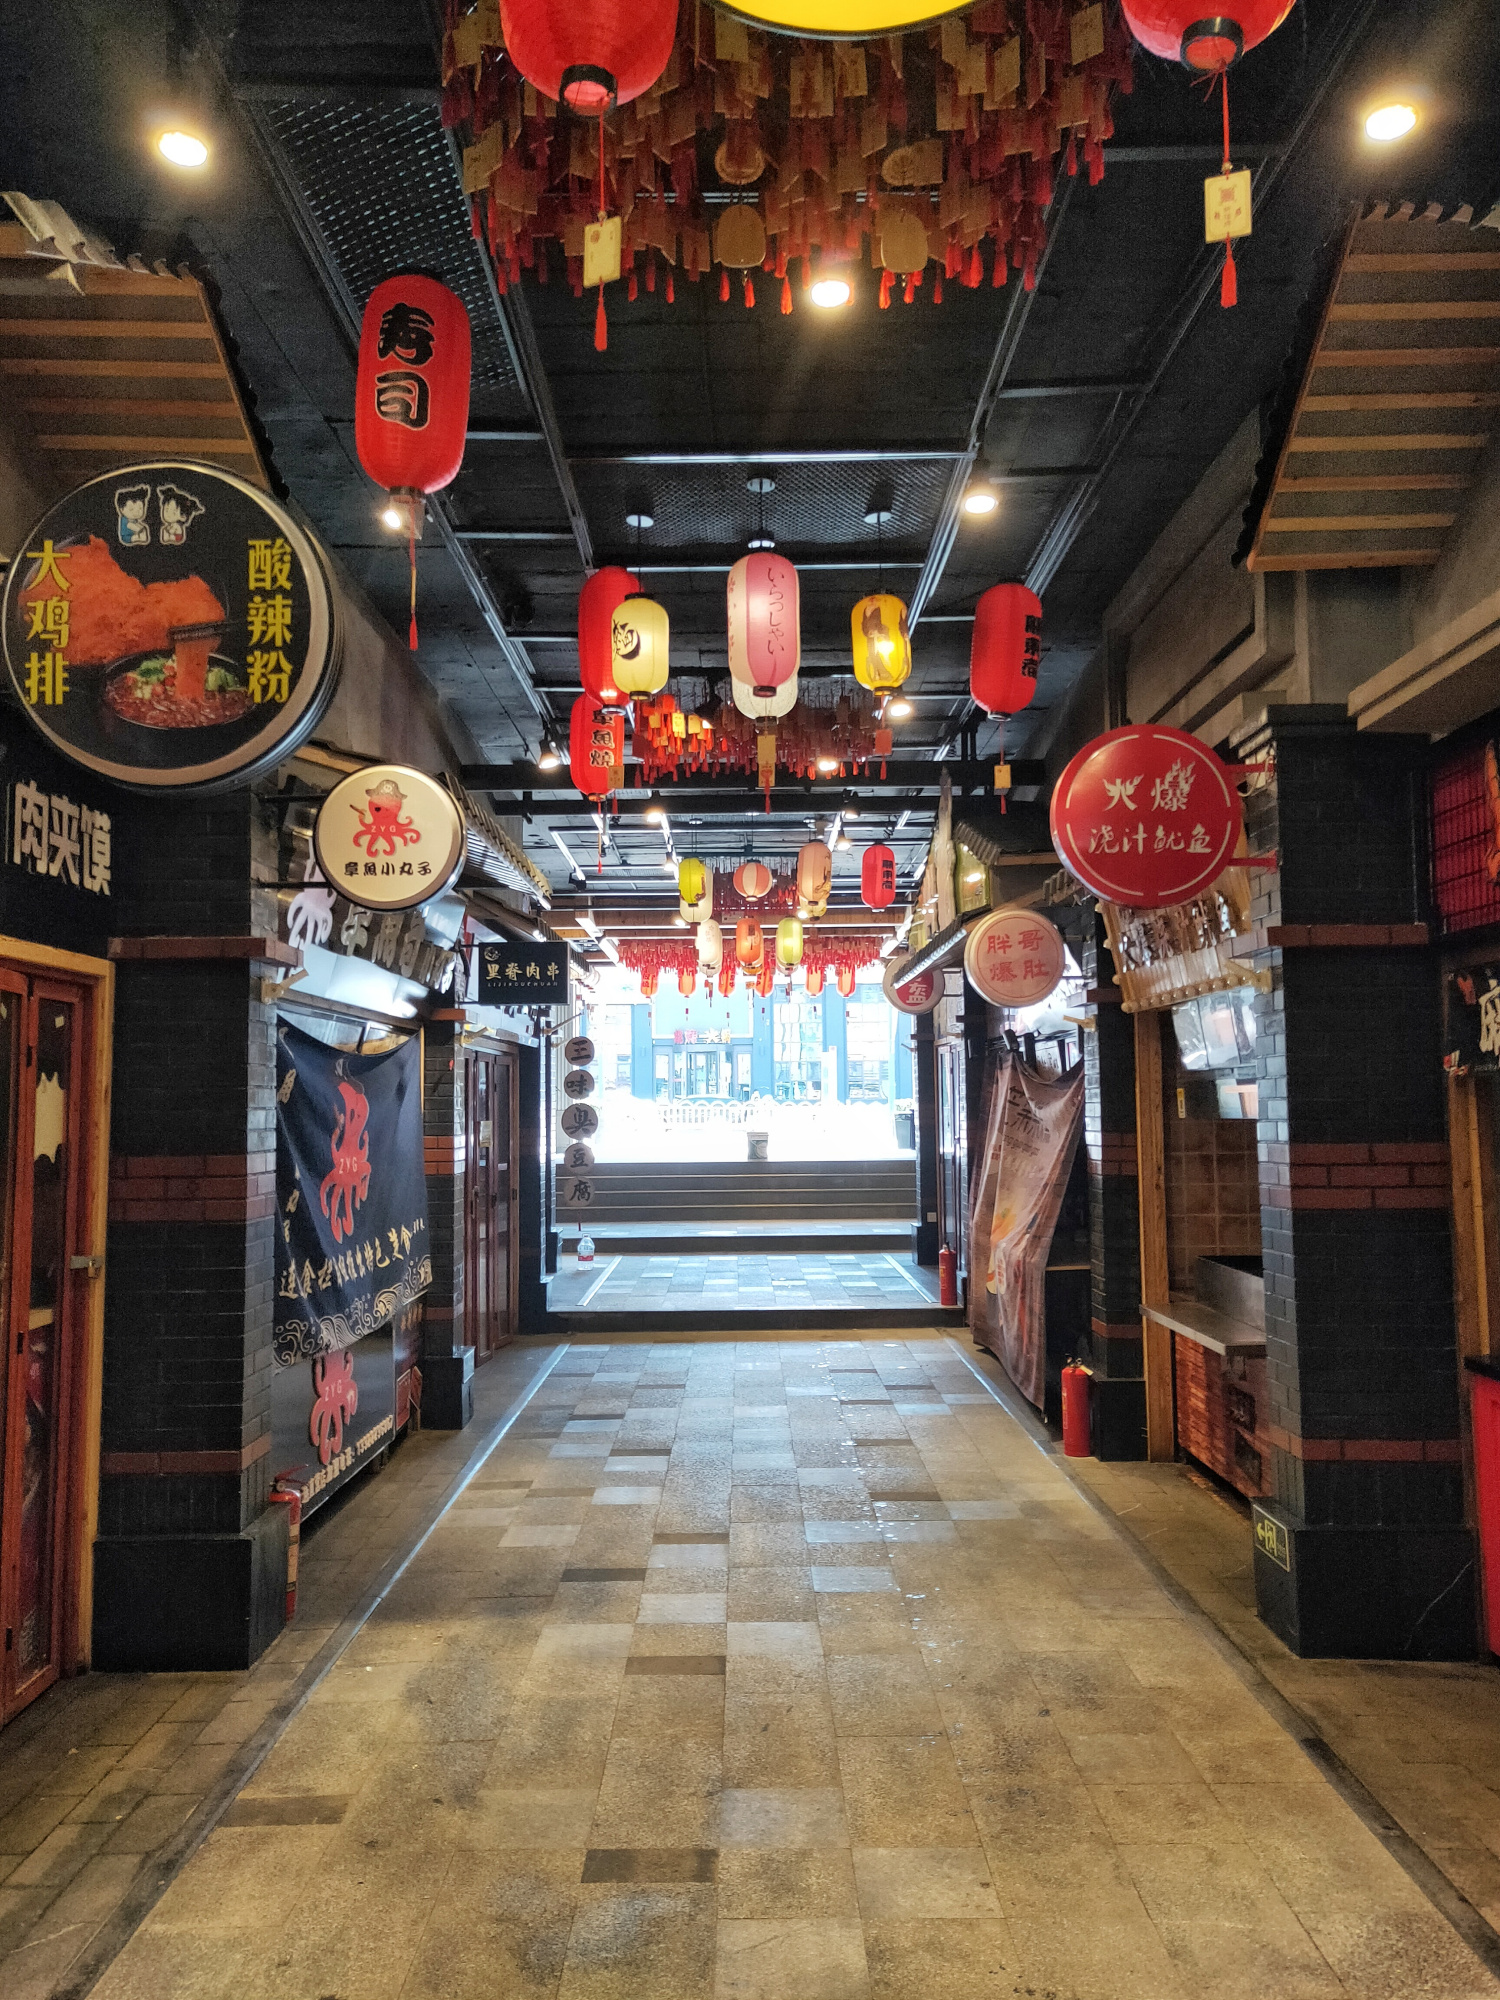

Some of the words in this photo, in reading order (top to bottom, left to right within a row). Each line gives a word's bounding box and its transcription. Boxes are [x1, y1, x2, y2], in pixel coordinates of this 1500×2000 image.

[25, 540, 71, 705] 大鸡排
[247, 538, 293, 704] 酸辣粉
[1103, 758, 1196, 812] 火爆
[13, 779, 112, 896] 肉夹馍
[371, 825, 397, 834] ZYG
[1088, 821, 1212, 855] 浇汁鱿鱼
[986, 929, 1045, 955] 胖哥
[485, 961, 560, 981] 里脊肉串
[989, 958, 1050, 983] 爆肚
[338, 1157, 358, 1175] ZYG
[325, 1379, 342, 1401] ZYG
